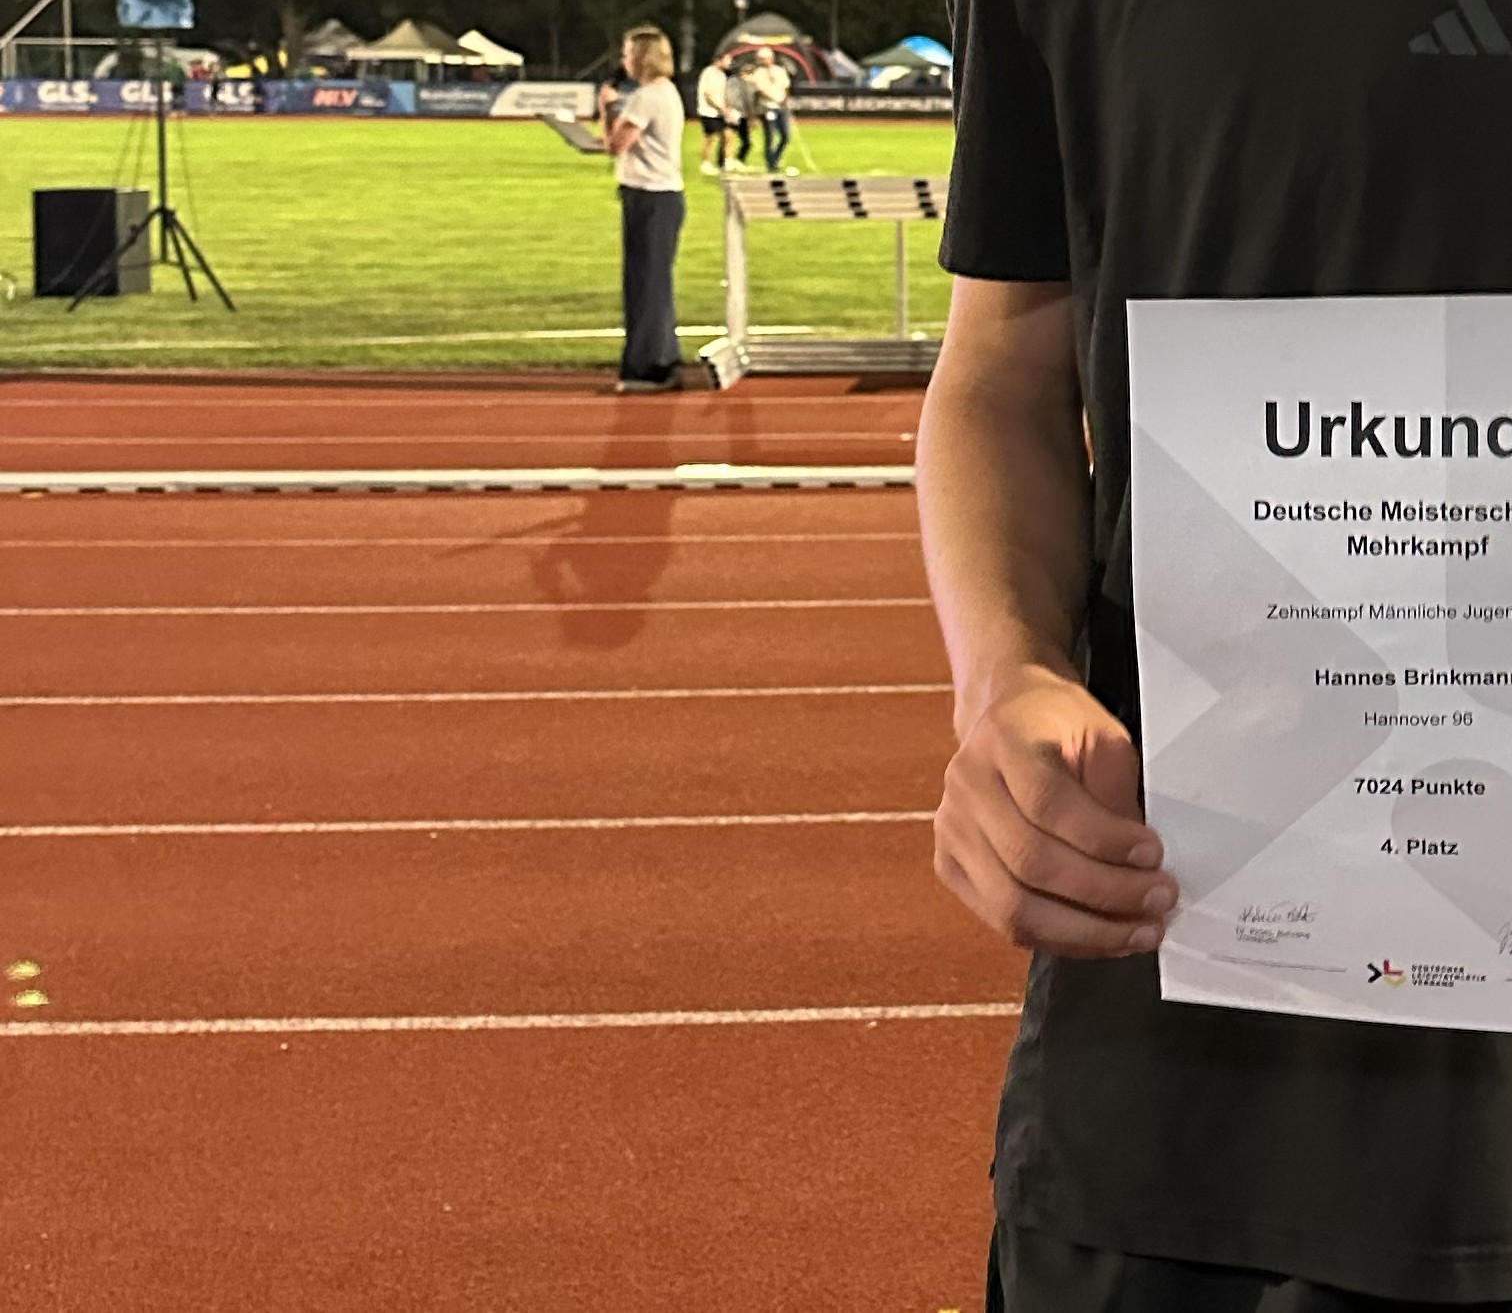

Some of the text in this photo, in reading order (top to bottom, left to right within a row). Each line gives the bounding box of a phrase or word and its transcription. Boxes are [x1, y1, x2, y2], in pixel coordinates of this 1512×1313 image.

[1252, 500, 1373, 524] Deutsche
[1346, 534, 1490, 562] Mehrkampf
[1266, 602, 1364, 623] Zehnkampf
[1369, 602, 1458, 621] Männliche
[1314, 668, 1397, 687] Hannes
[1363, 710, 1474, 728] Hannover 96
[1353, 778, 1486, 796] 7024 Punkte
[1380, 838, 1459, 857] 4. Platz
